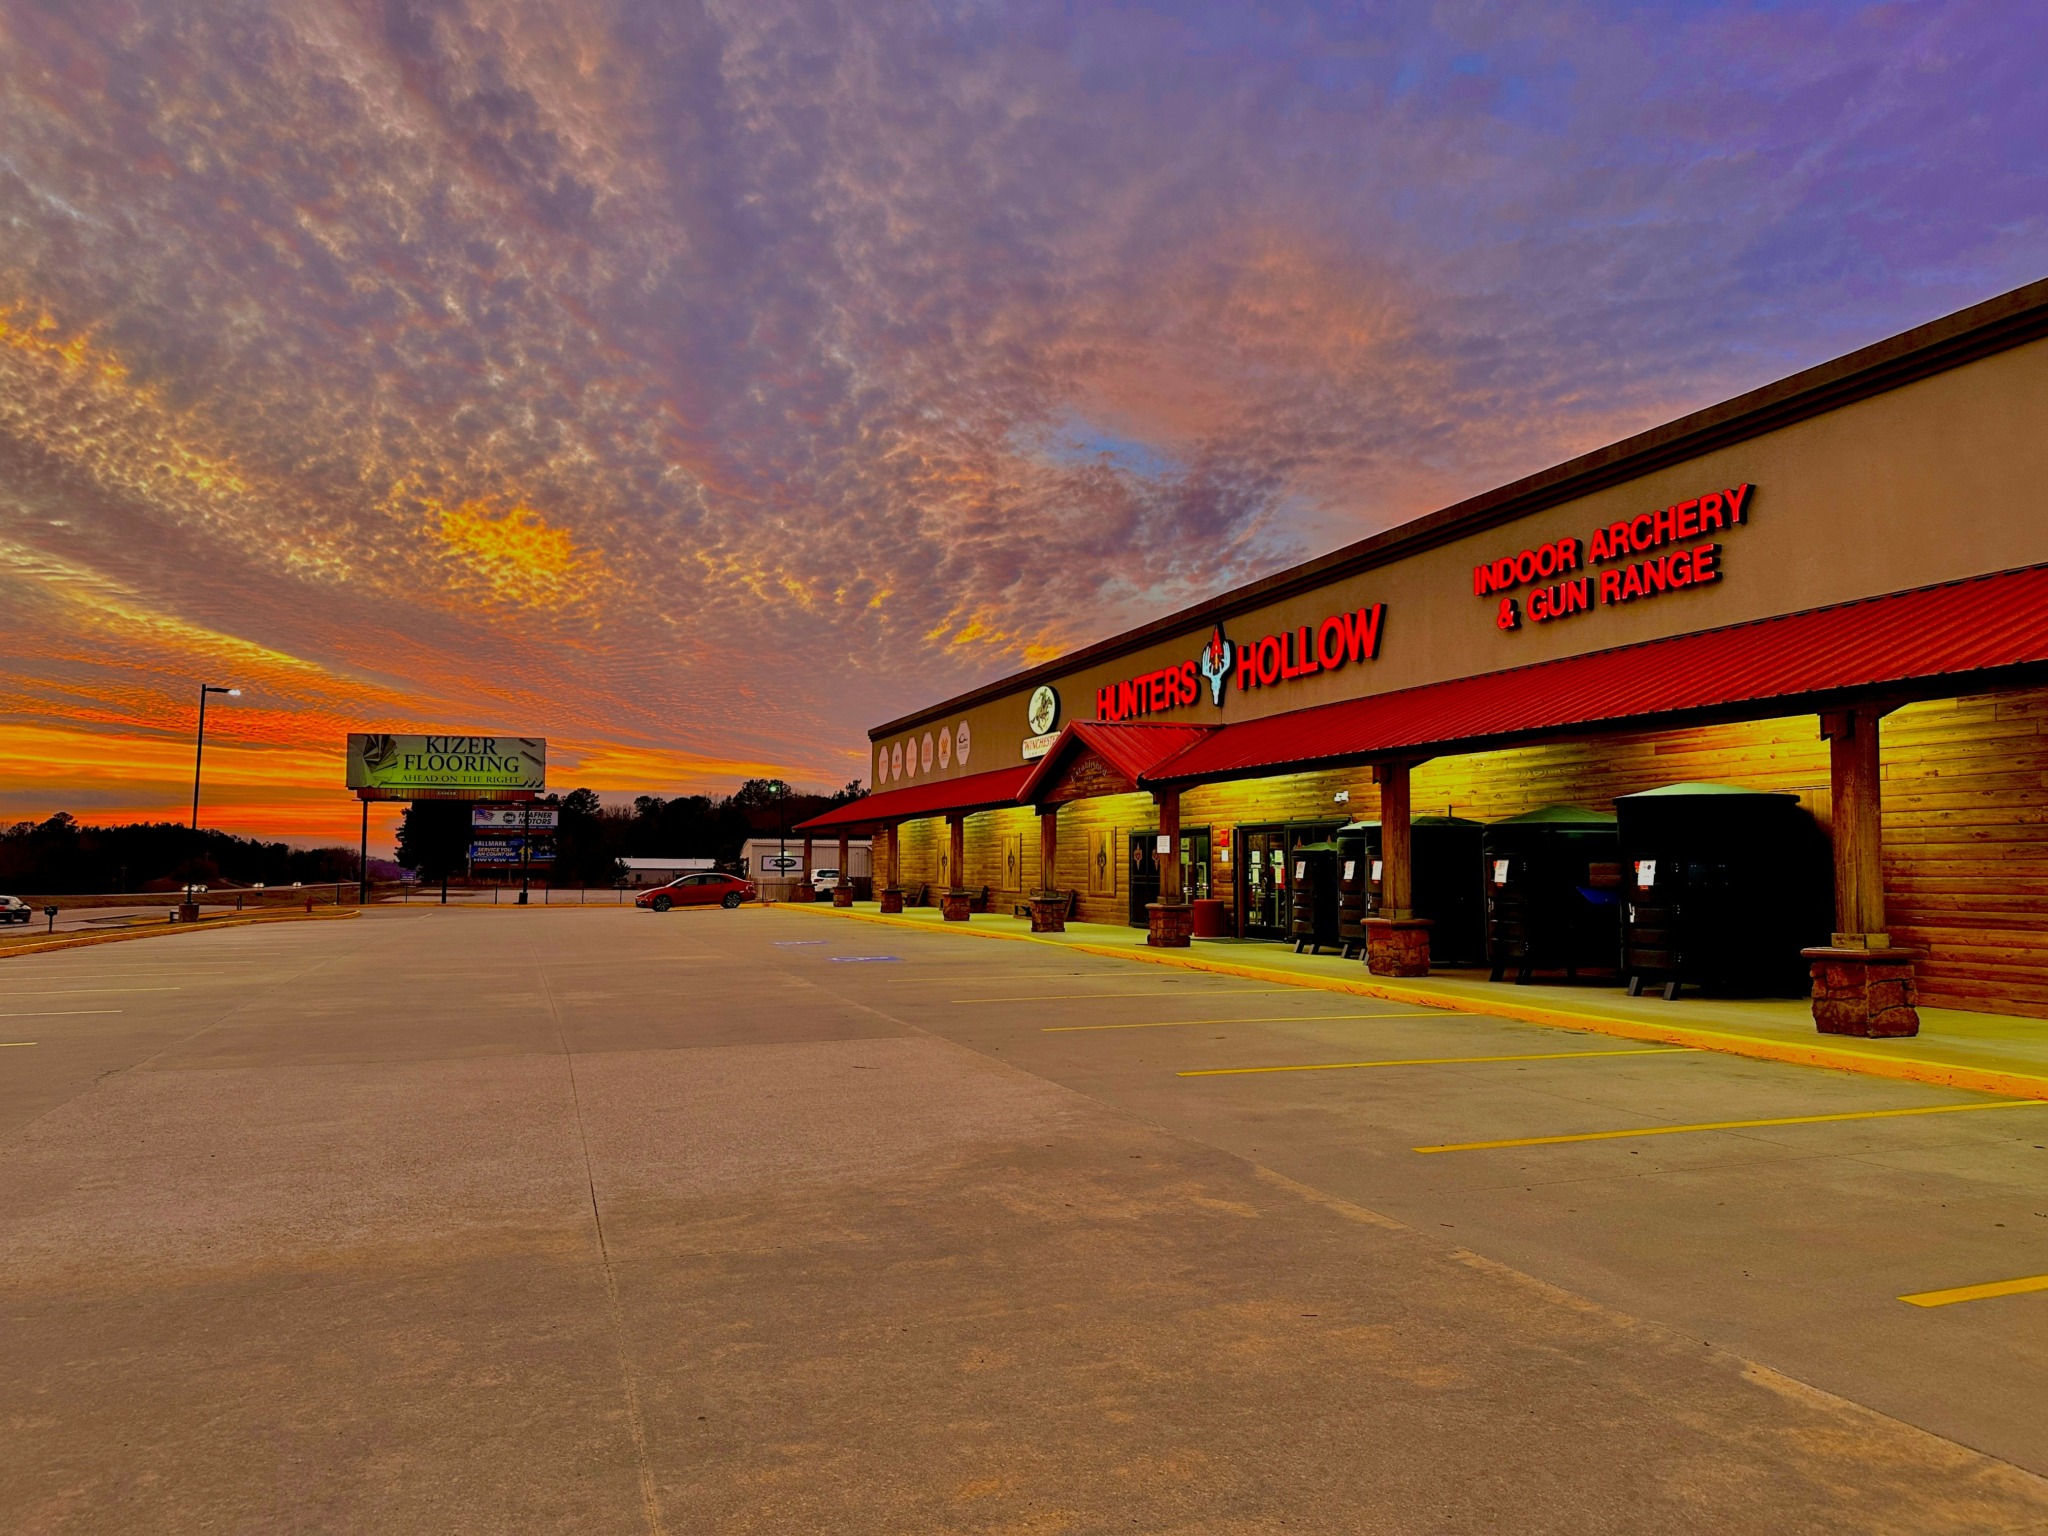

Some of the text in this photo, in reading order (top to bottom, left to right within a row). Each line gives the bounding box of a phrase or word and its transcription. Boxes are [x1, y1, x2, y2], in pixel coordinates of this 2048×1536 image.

[1473, 483, 1753, 596] INDOOR ARCHERY
[1497, 543, 1720, 630] & GUN RANGE
[1096, 603, 1384, 721] HUNTERS HOLLOW
[425, 736, 498, 755] KIZER
[404, 754, 519, 773] FLOORING
[401, 774, 521, 784] AHEAD ON THE RIGHT
[518, 811, 553, 819] HAFNER
